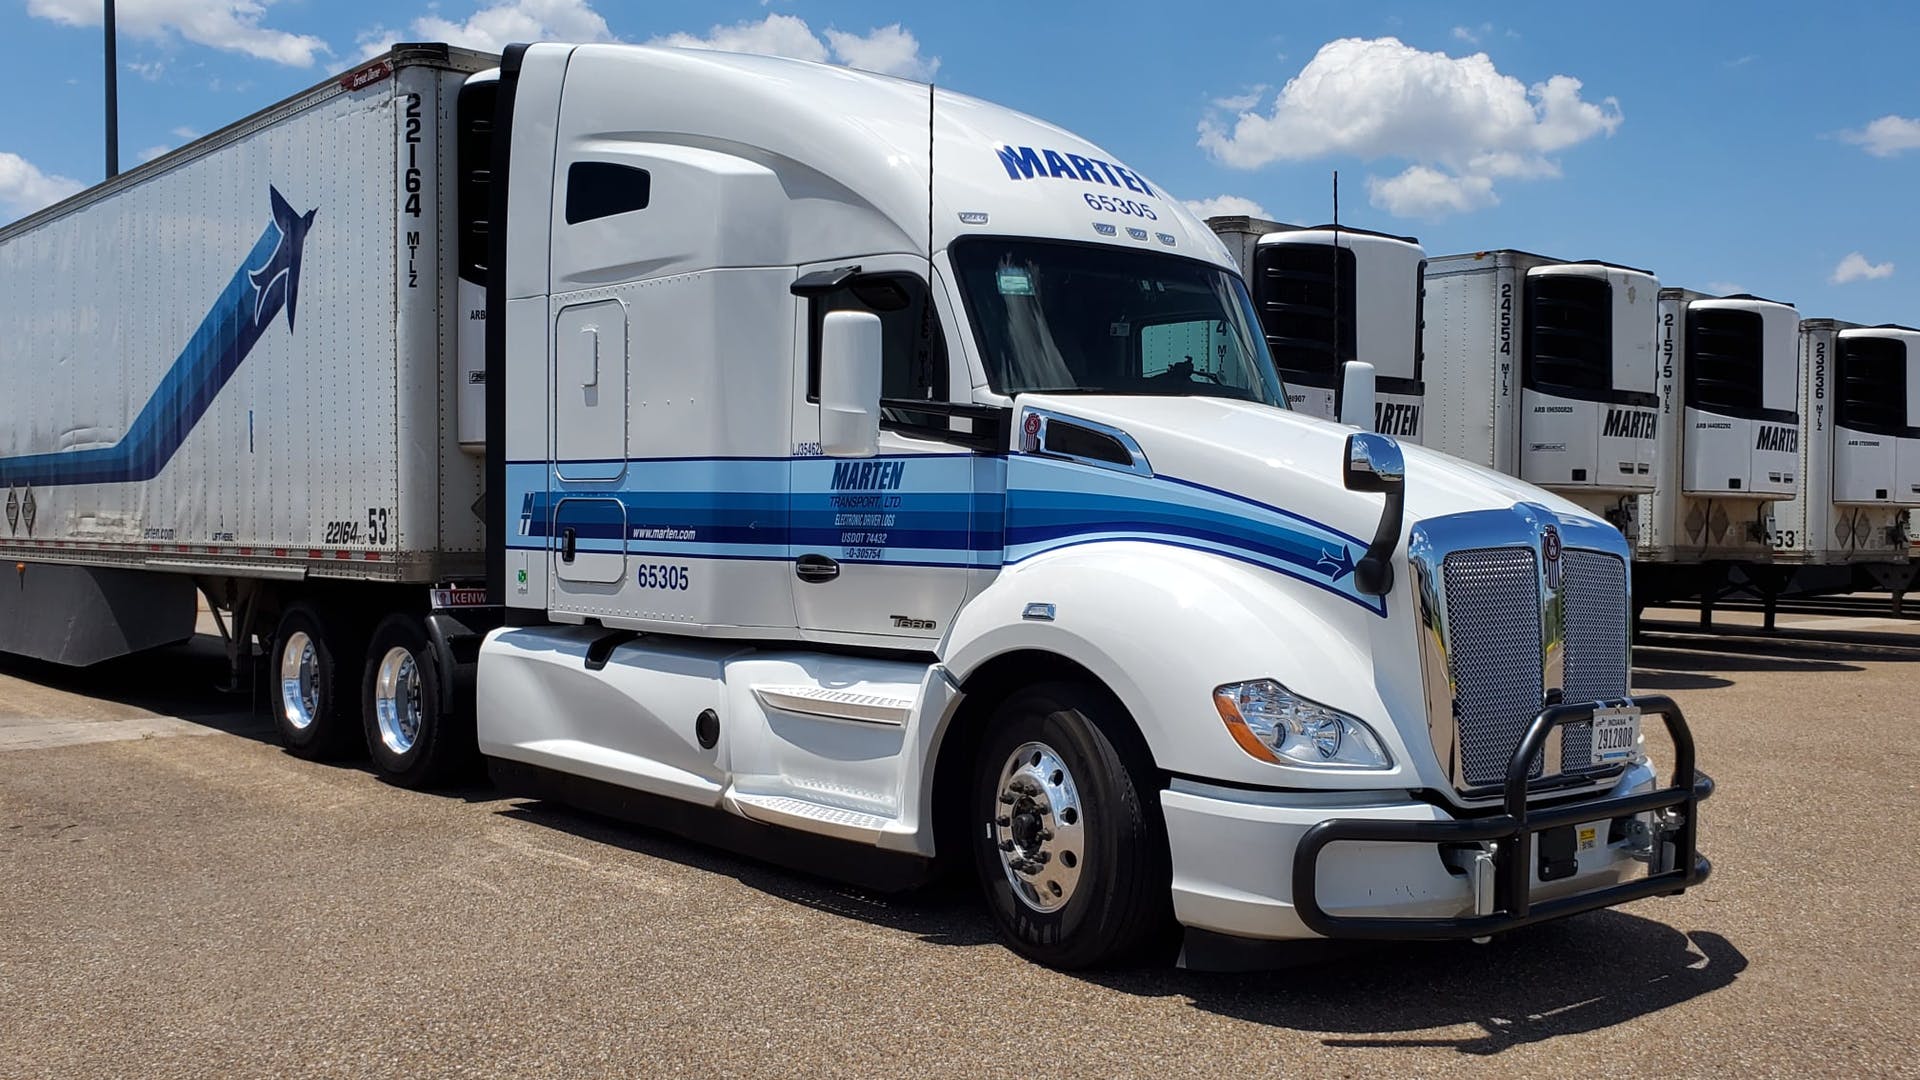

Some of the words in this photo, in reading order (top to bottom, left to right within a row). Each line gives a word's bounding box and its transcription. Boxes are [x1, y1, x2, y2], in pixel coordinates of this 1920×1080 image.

[405, 93, 422, 218] 22164
[1083, 193, 1158, 221] 65305
[407, 231, 420, 289] MTLZ
[1500, 283, 1512, 356] 24554
[1663, 313, 1674, 378] 21575
[1501, 363, 1510, 396] MTLZ
[1815, 342, 1825, 399] 23236
[1663, 385, 1672, 414] MTLZ
[1375, 402, 1420, 436] ARTEN
[1603, 409, 1658, 440] MARTEN
[1815, 404, 1823, 431] MTLZ
[1756, 425, 1798, 453] MARTEN
[831, 461, 905, 490] MARTEN
[325, 521, 358, 544] 22164
[632, 526, 697, 540] www.marten.com
[834, 513, 863, 526] ELECTRONIC
[881, 514, 896, 527] LOGS
[842, 533, 865, 543] USDOT
[866, 533, 888, 544] 74432
[638, 563, 689, 591] 65305
[452, 592, 487, 604] KENW
[889, 614, 937, 630] T680
[1607, 718, 1627, 727] INDIANA
